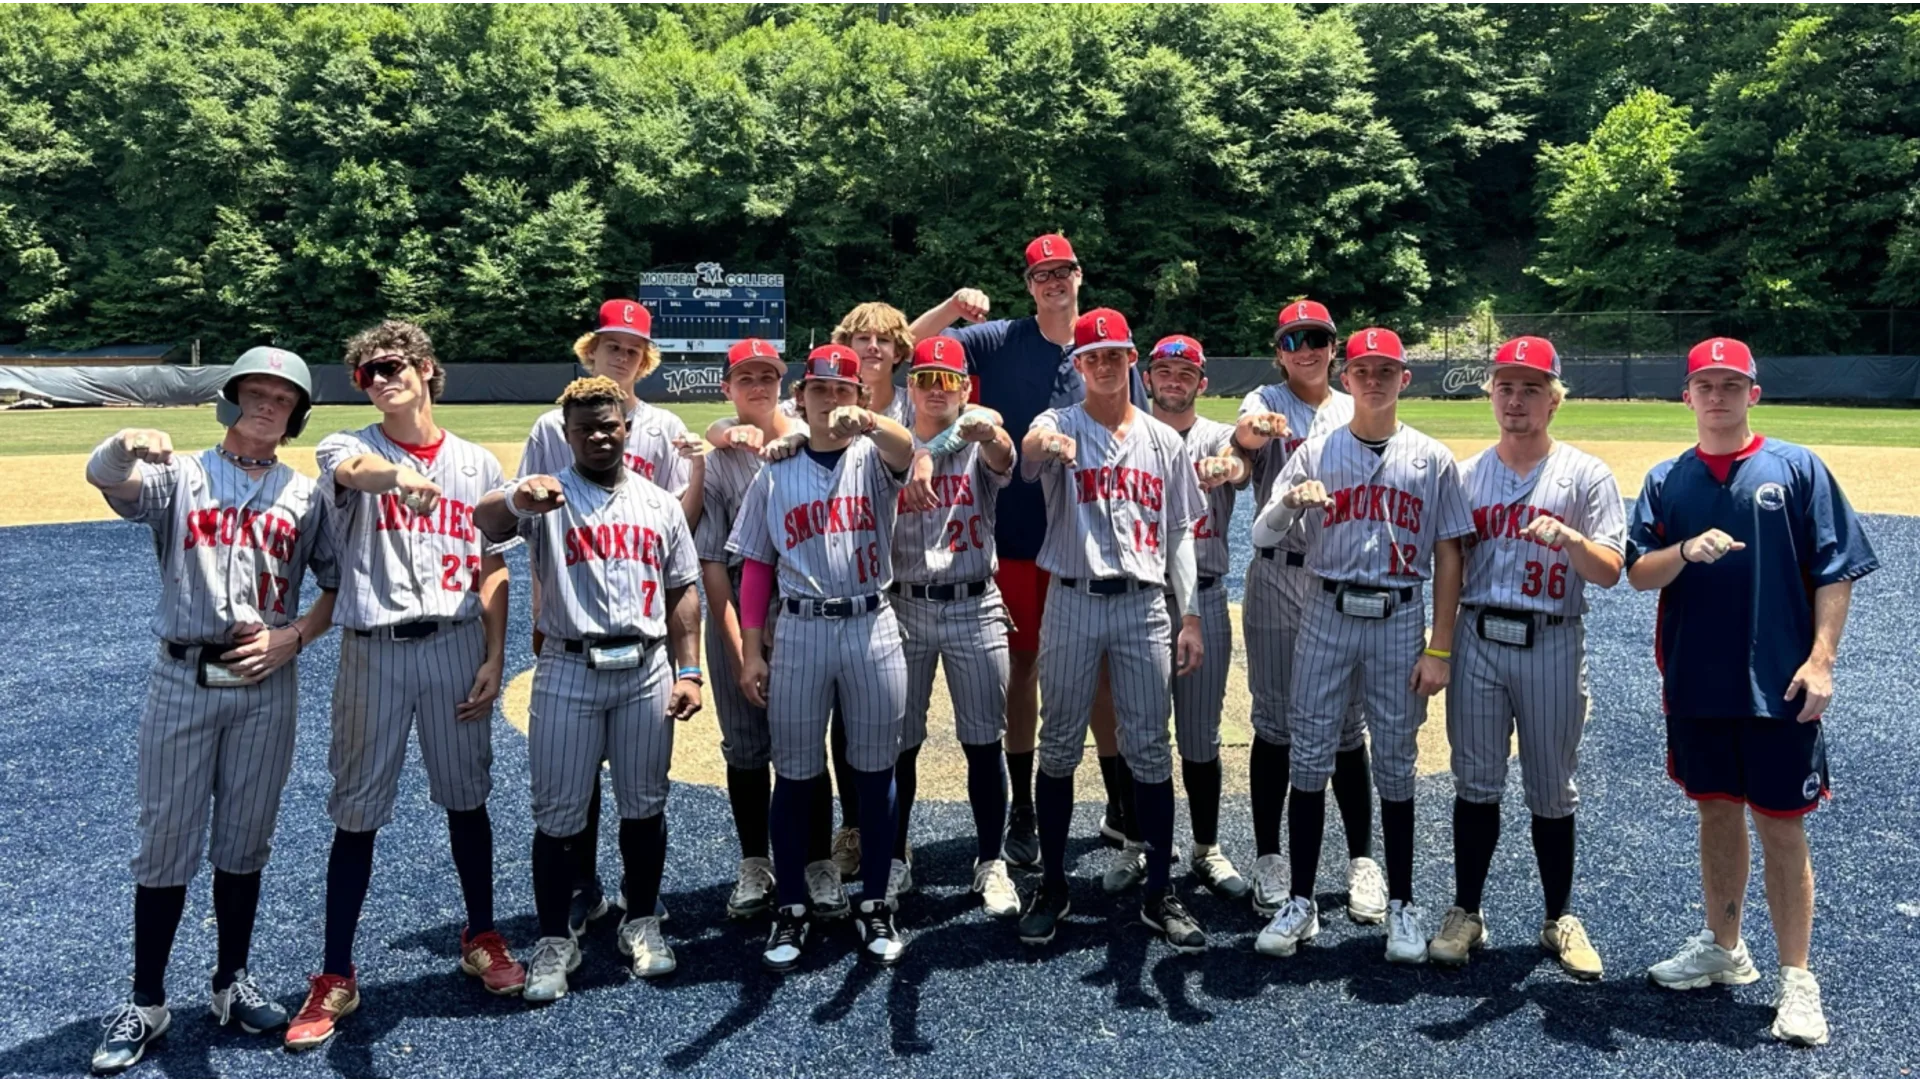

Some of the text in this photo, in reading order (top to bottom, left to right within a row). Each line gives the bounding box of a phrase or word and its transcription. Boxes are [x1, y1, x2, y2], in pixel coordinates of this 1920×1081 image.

[1042, 240, 1052, 256] C
[639, 272, 784, 287] MONTREAT COLLEGE
[624, 305, 634, 323] C
[1298, 303, 1308, 319] C
[1096, 317, 1107, 337] C
[751, 339, 762, 356] C
[934, 341, 944, 360] C
[1366, 331, 1377, 350] C
[269, 350, 284, 368] C
[1515, 341, 1528, 361] C
[1712, 341, 1724, 361] C
[1324, 484, 1423, 534] SMOKIES
[1134, 519, 1161, 554] 14
[855, 541, 880, 584] 18
[1388, 541, 1420, 577] 12
[1521, 560, 1568, 600] 36
[641, 580, 658, 617] 7
